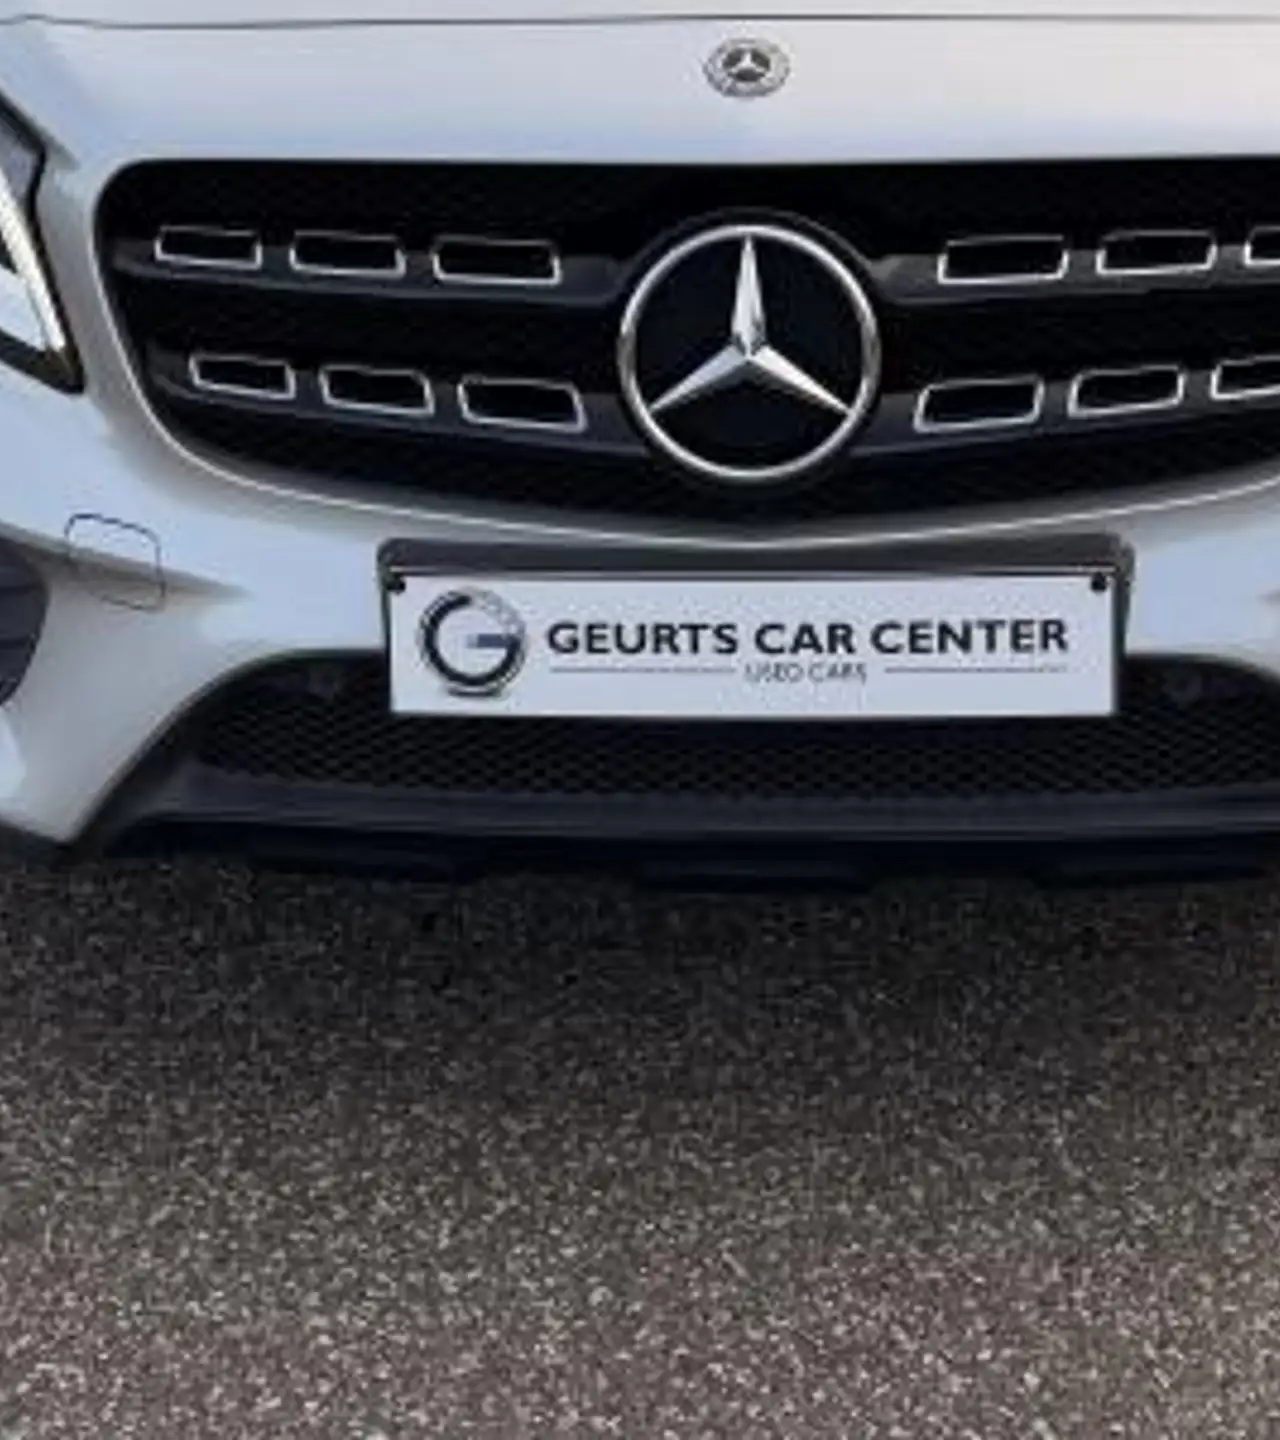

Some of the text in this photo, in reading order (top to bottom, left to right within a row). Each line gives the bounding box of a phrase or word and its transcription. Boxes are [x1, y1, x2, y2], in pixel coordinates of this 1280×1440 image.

[547, 618, 1069, 655] GEURTS CAR CENTER
[745, 660, 867, 684] USED CARS
